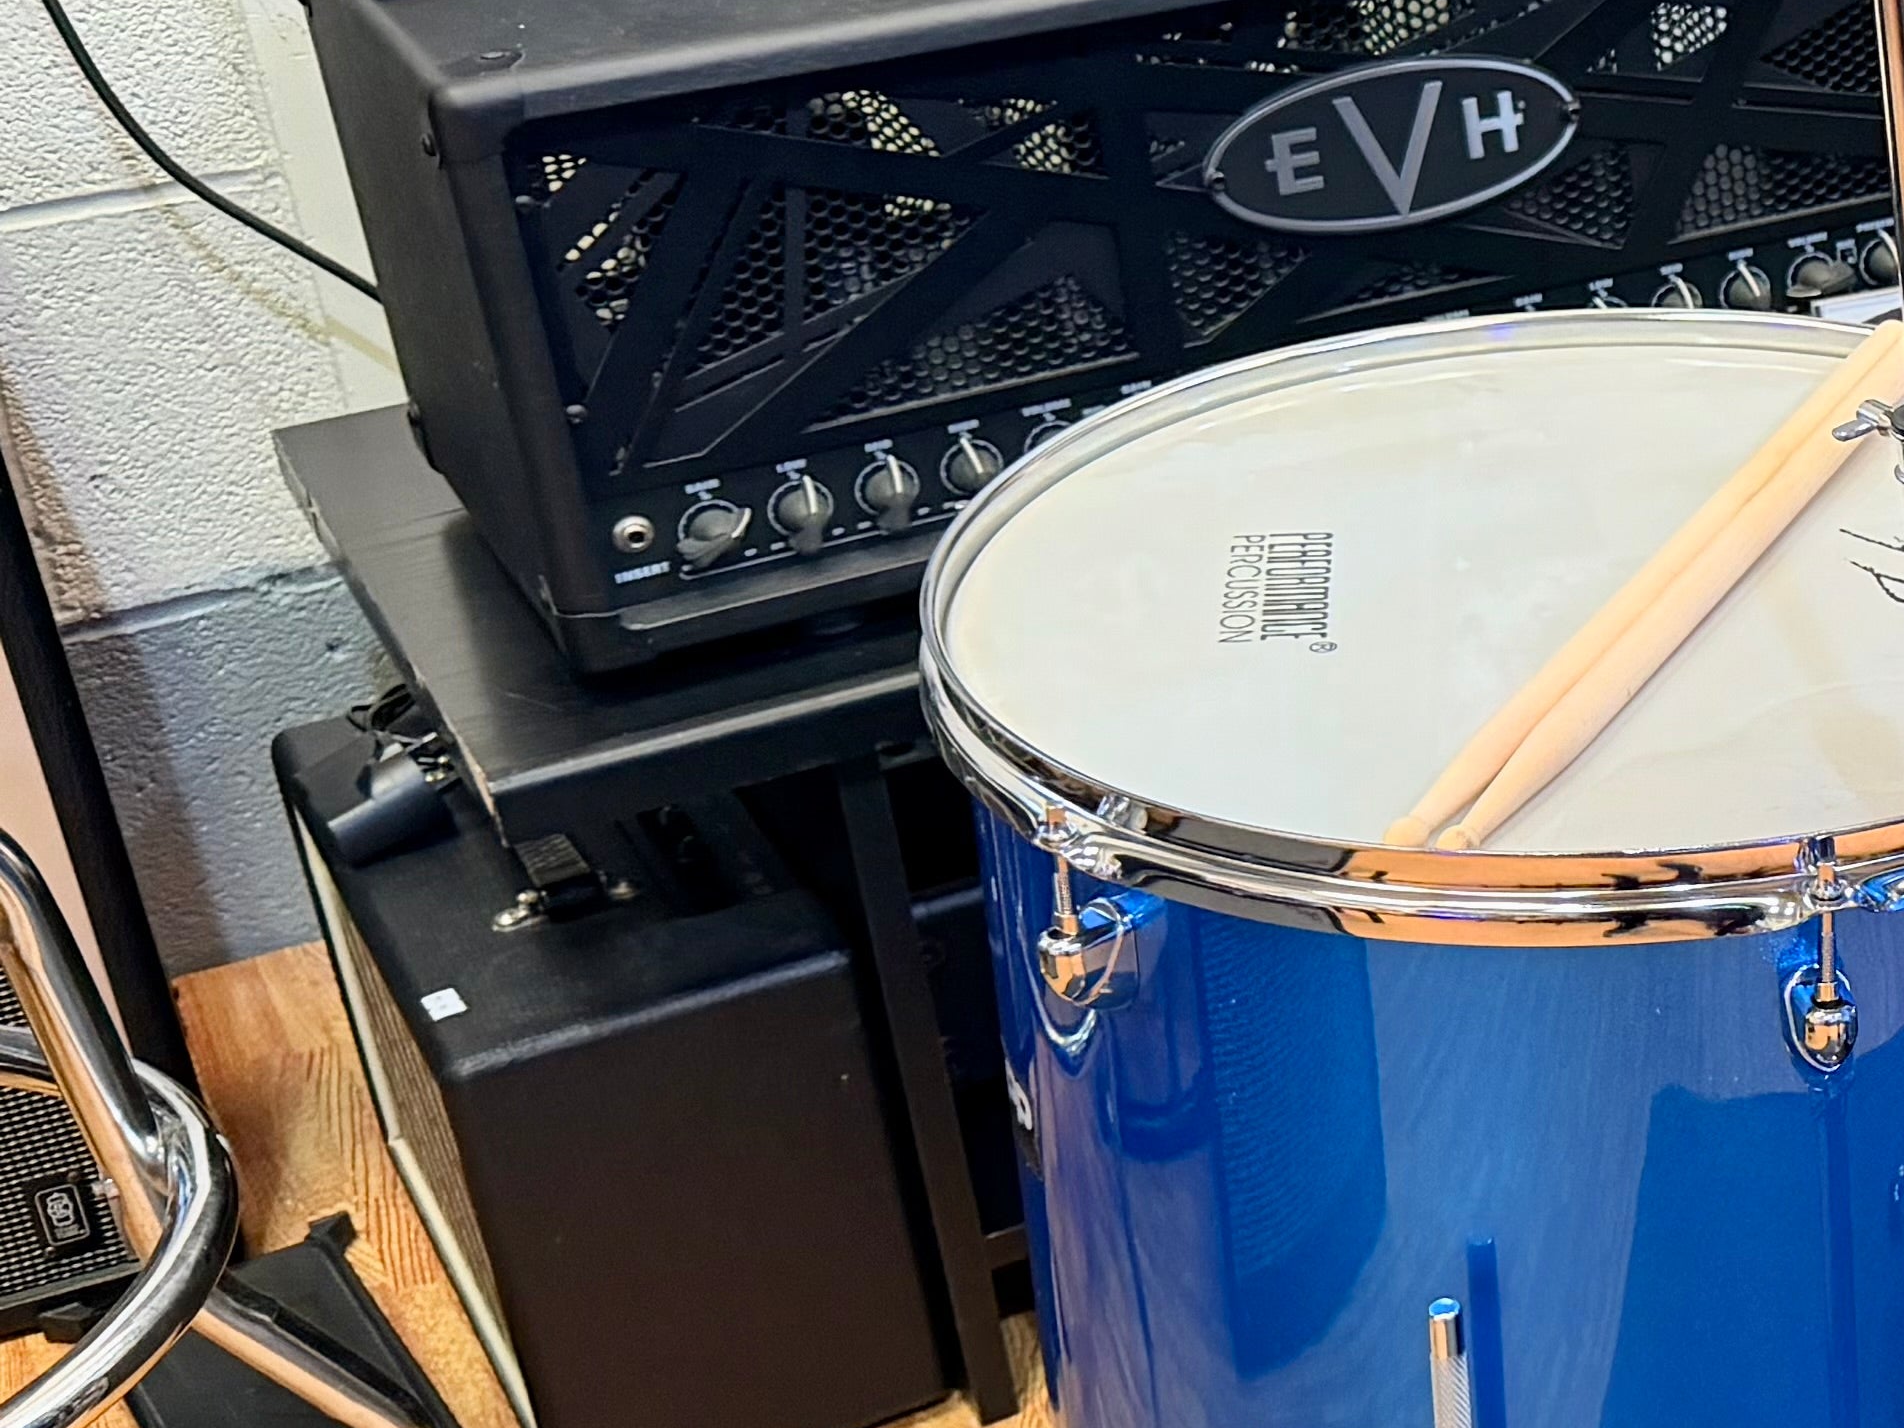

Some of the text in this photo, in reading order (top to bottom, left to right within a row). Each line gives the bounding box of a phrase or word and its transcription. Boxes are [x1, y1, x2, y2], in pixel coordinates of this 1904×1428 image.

[1264, 80, 1526, 215] EVH
[1218, 534, 1267, 643] PERCUSSION
[1260, 532, 1334, 641] PERFORMANCE
